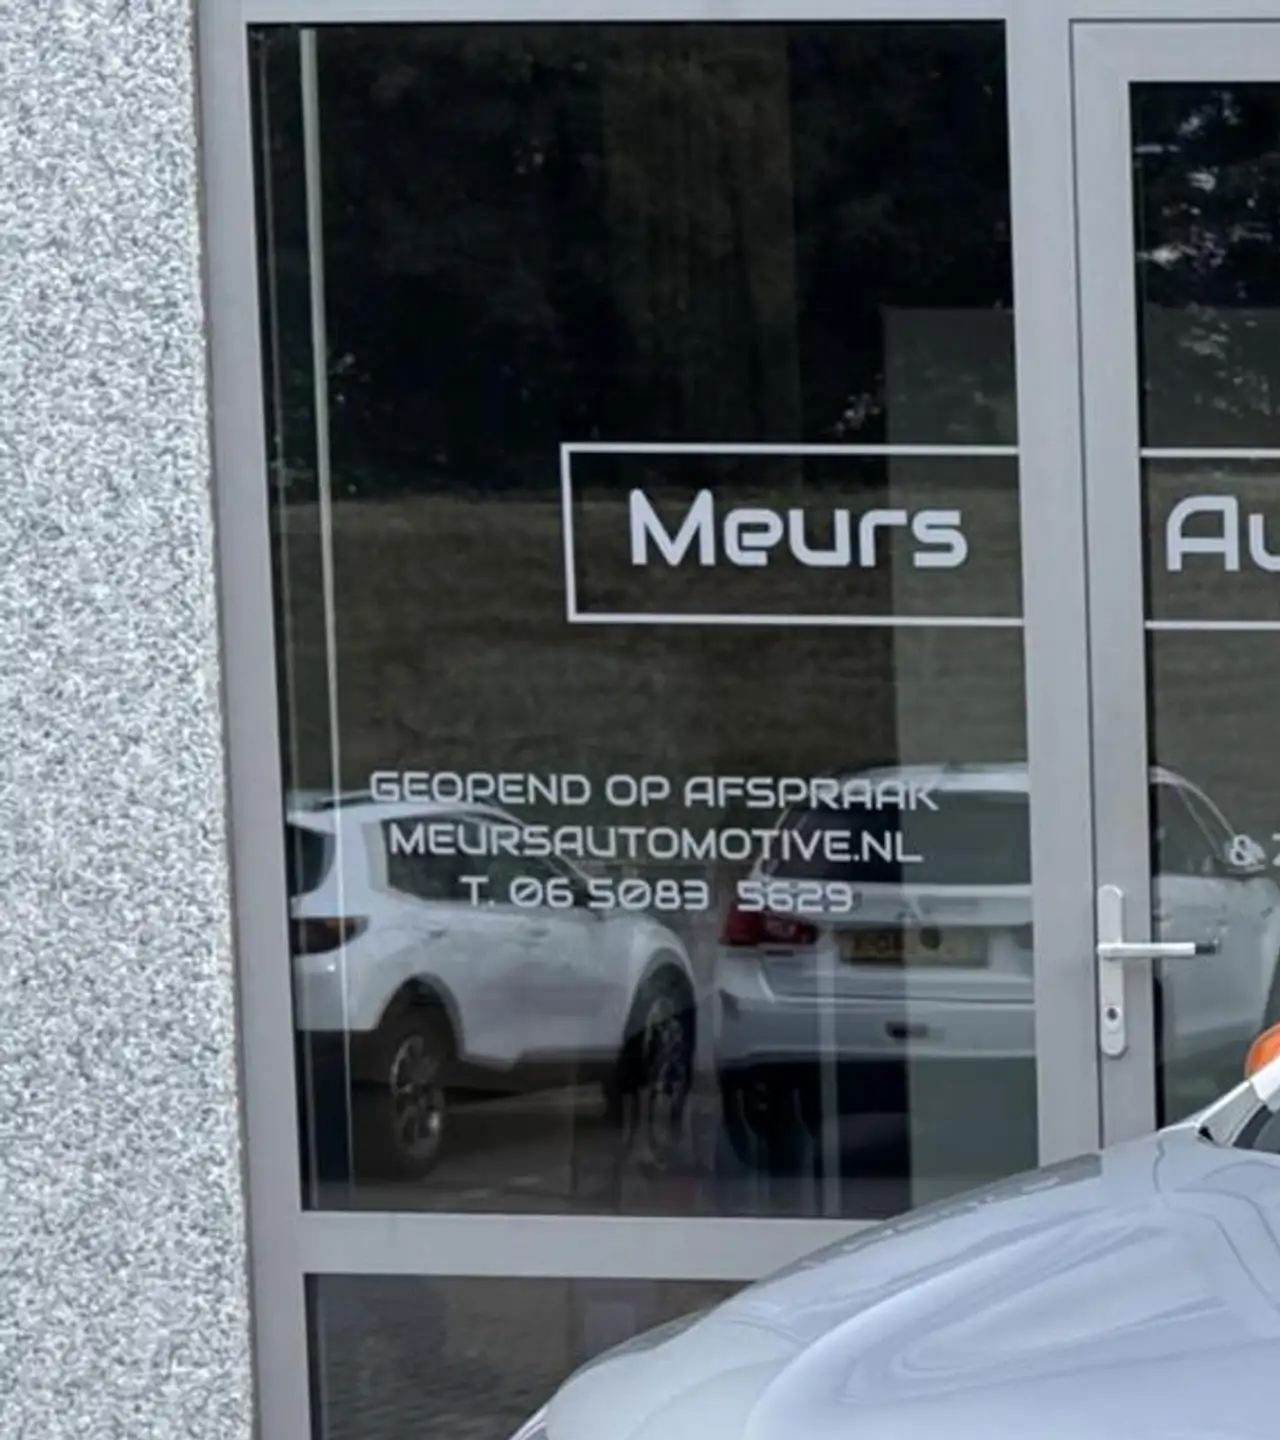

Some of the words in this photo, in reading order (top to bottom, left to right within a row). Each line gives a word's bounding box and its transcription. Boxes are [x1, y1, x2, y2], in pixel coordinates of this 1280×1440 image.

[629, 487, 968, 568] Meurs
[369, 770, 592, 806] GEOPEND
[604, 773, 671, 807] OP
[684, 775, 940, 812] AFSPRAAK
[389, 821, 924, 863] MEURSAUTOMOTIVE.NL
[458, 875, 496, 908] T.
[508, 876, 574, 909] 06
[587, 877, 710, 911] 5083
[736, 879, 854, 912] 5629
